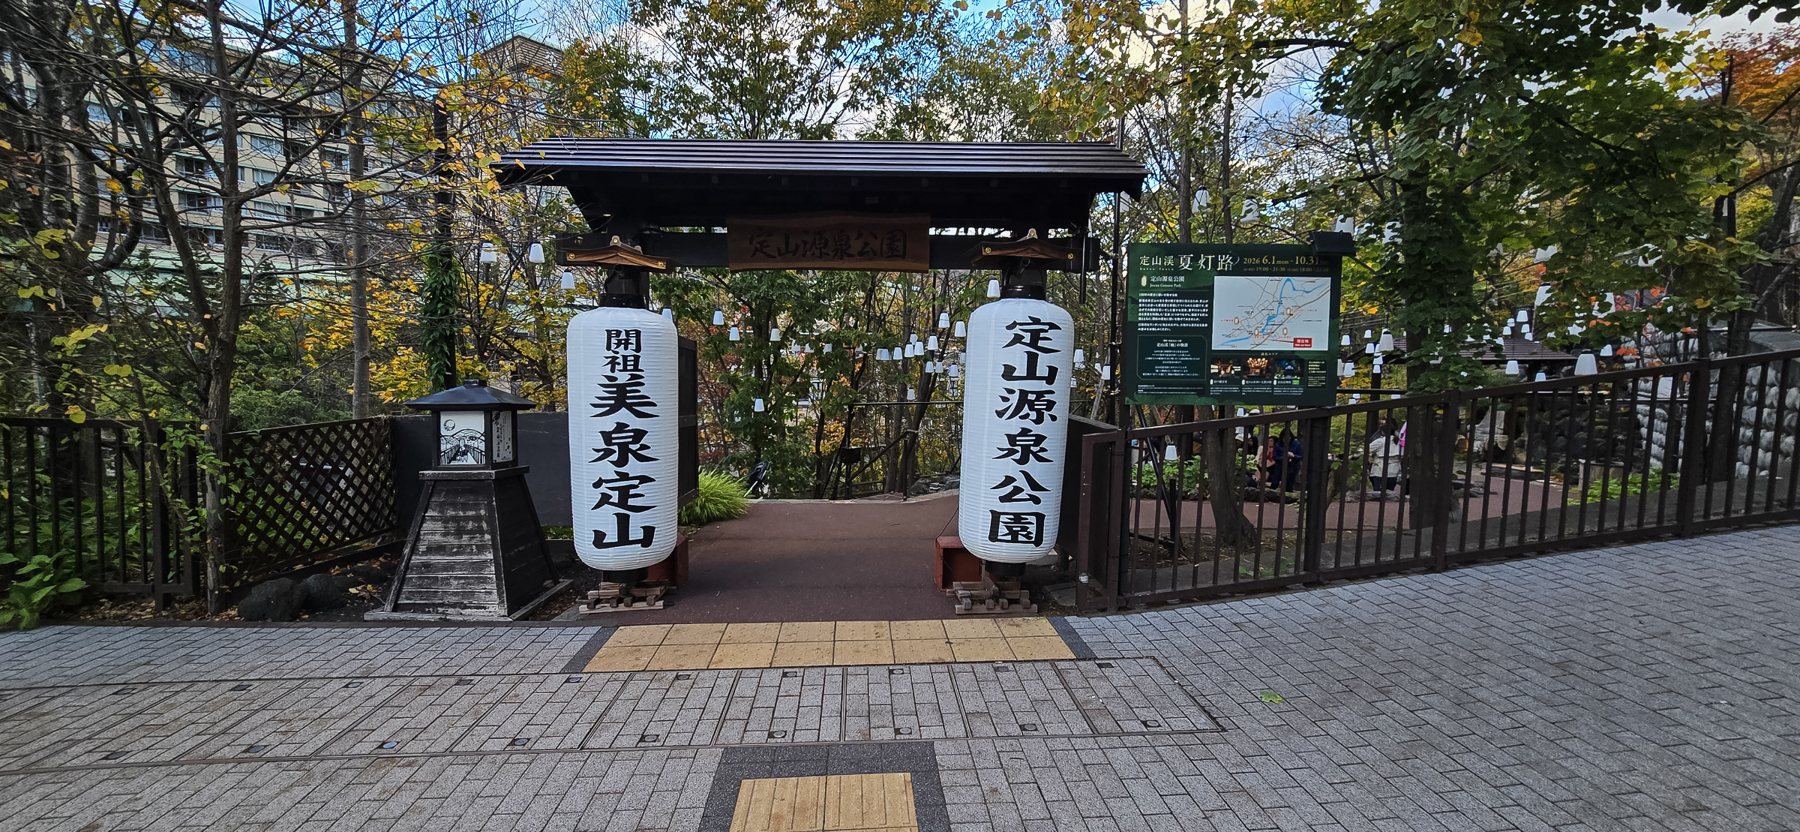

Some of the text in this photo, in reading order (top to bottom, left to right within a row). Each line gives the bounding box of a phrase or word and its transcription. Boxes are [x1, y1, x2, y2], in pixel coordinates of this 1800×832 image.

[750, 227, 907, 259] 定山源泉公園
[1178, 253, 1234, 271] 夏灯路
[590, 328, 659, 550] 開祖美泉定山
[988, 316, 1062, 548] 定山源泉公園
